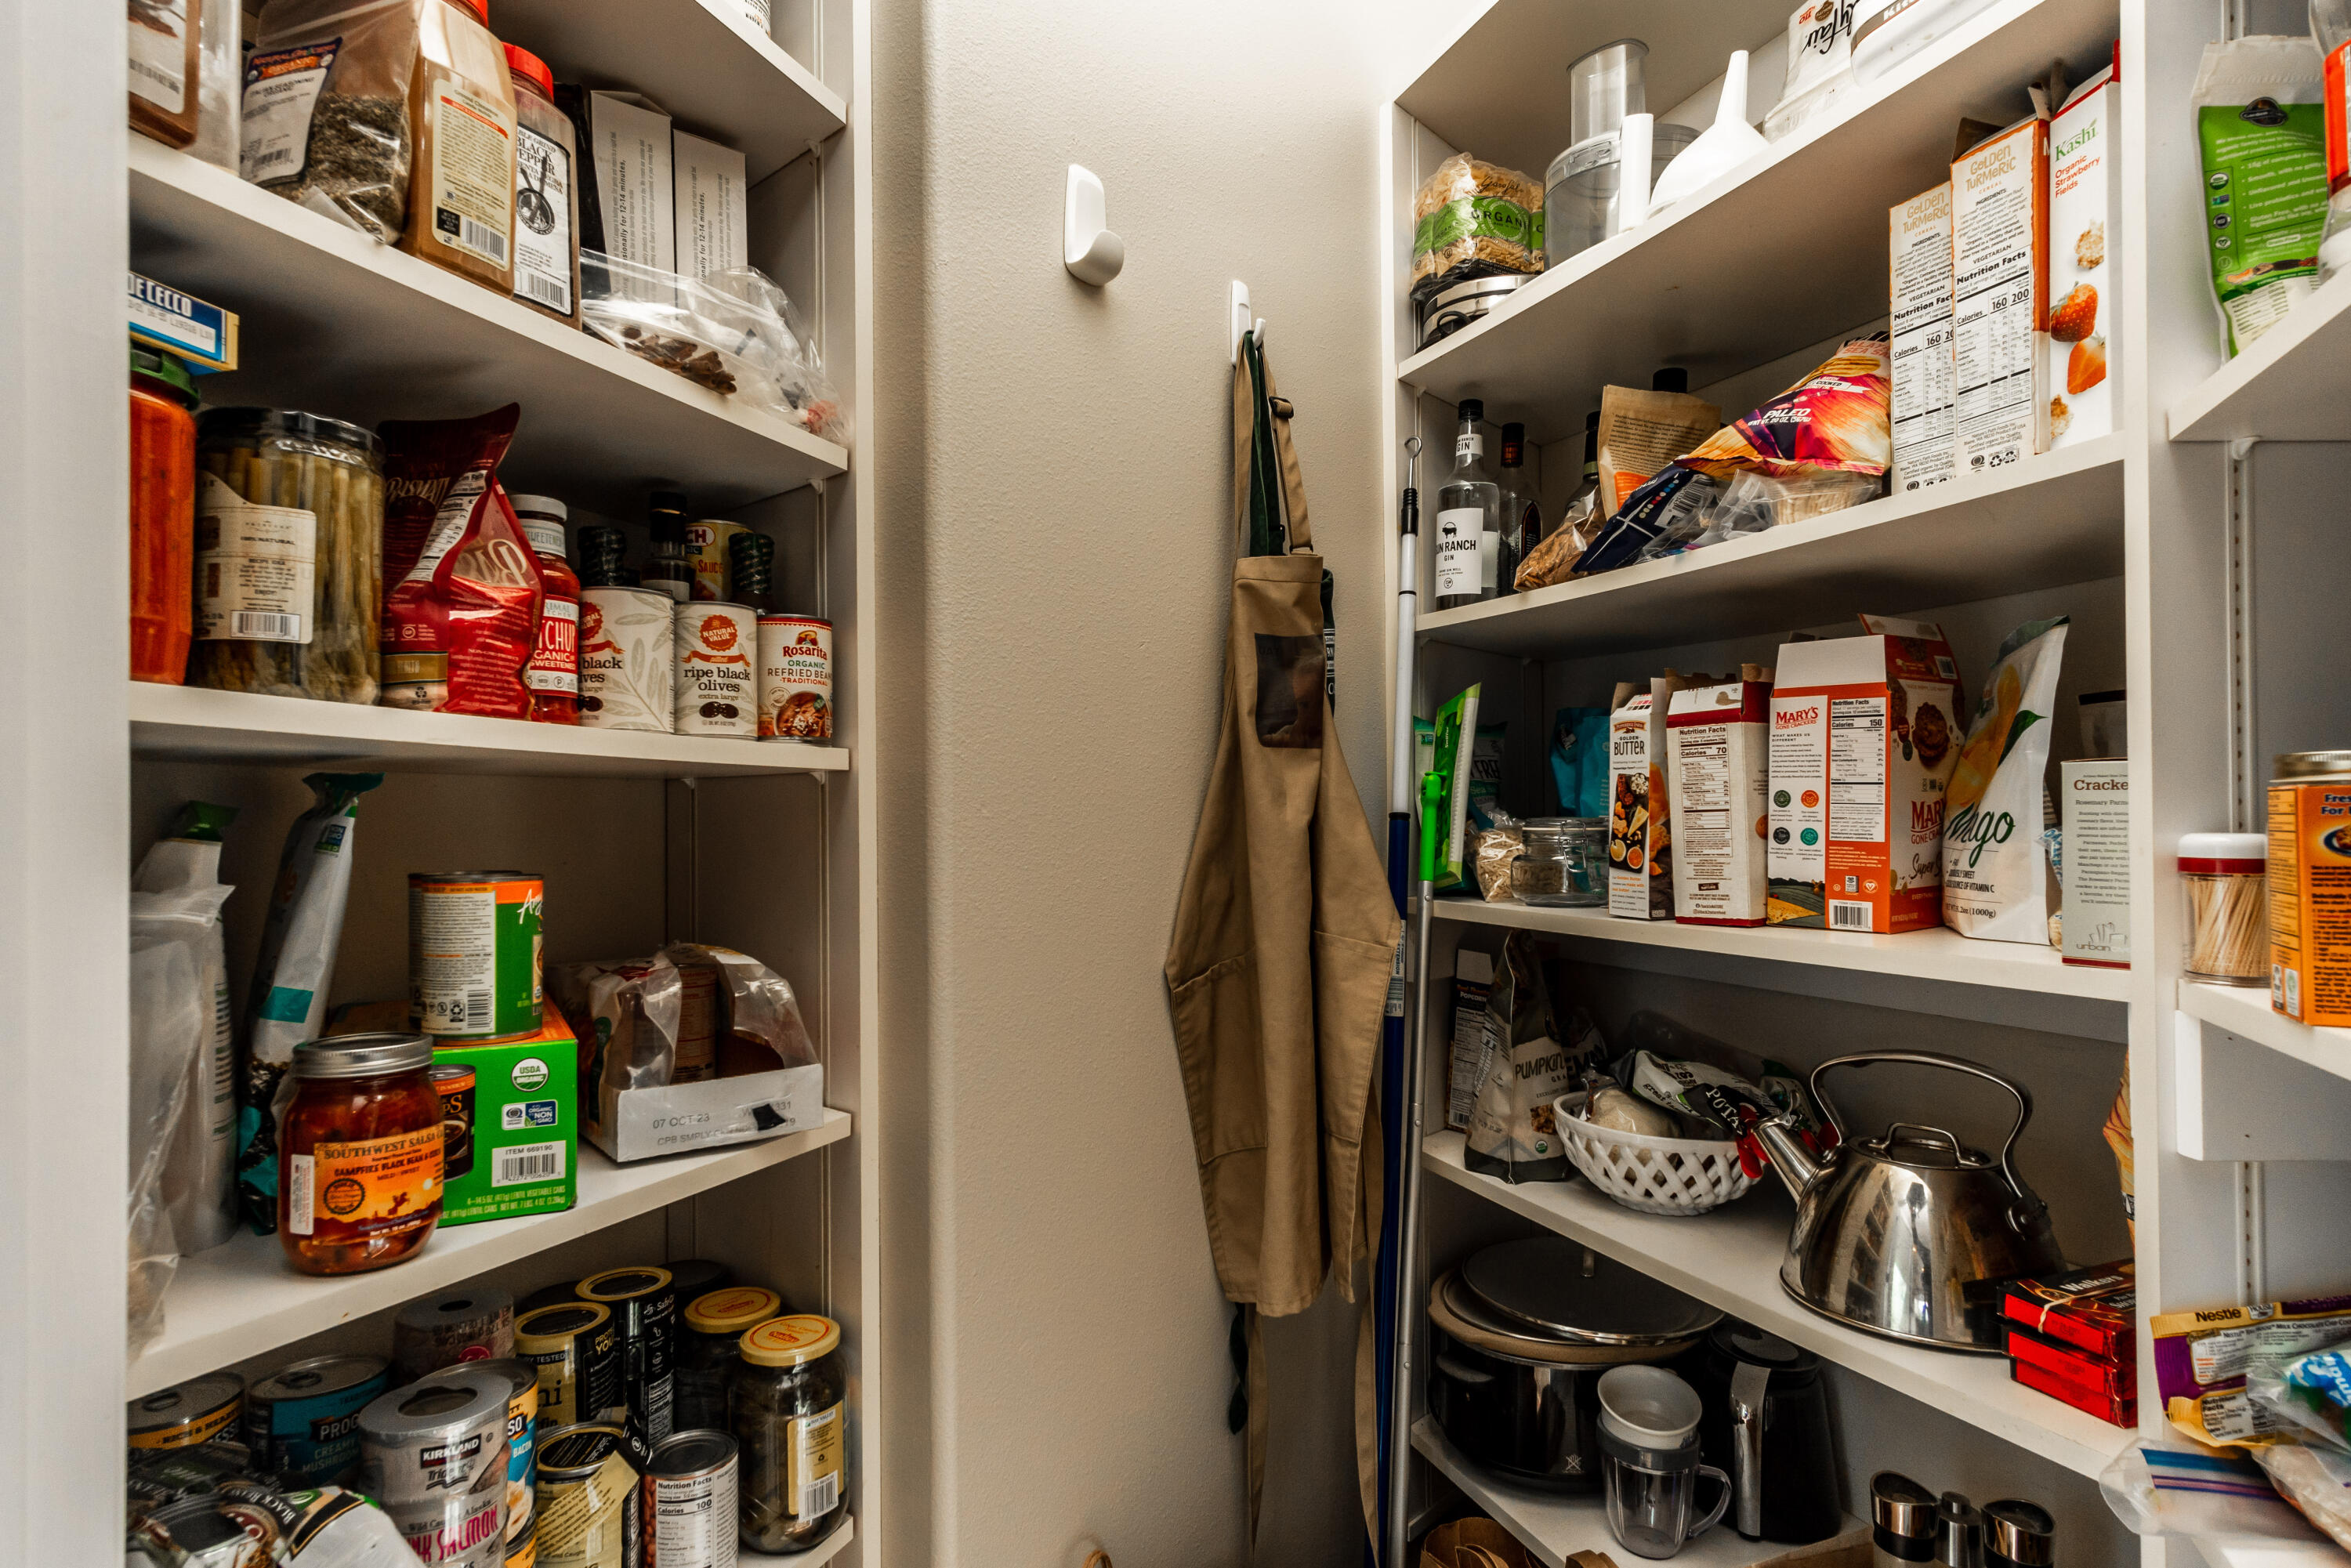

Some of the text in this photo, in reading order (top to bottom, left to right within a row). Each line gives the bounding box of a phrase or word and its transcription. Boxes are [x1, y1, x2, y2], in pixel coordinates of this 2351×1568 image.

[516, 136, 552, 163] BLACK
[2055, 125, 2098, 161] Kashi
[516, 150, 556, 176] EPPR
[2055, 154, 2088, 179] Organic
[2055, 157, 2101, 190] Strawberry
[2055, 179, 2078, 198] Fields
[1471, 208, 1527, 230] ORGANI
[1972, 244, 2012, 264] VEGETARIAN
[1956, 251, 2027, 285] Nutrition Facts
[146, 280, 192, 317] CECCO
[1908, 284, 1946, 303] VEGETARIAN
[1893, 293, 1954, 321] Nutrition Fact
[1957, 288, 2030, 324] Calories 160 200
[1893, 327, 1954, 358] Calories 160 20
[1762, 407, 1812, 419] PALEO
[1457, 441, 1470, 452] GIN
[1444, 539, 1476, 552] RANCH
[702, 627, 736, 638] NATURAL
[708, 632, 730, 643] VALUE
[534, 650, 571, 662] GANIC
[782, 646, 828, 661] Rosarita
[582, 656, 624, 669] black
[788, 660, 826, 670] ORGANIC
[579, 672, 605, 683] ives
[683, 666, 751, 681] ripe black
[767, 668, 833, 681] REFRIED BEAN
[697, 679, 741, 693] olives
[720, 693, 739, 702] large
[1775, 706, 1819, 725] MARY'S
[1790, 719, 1817, 729] CRACKERS
[2073, 779, 2128, 791] Cracke
[1911, 798, 1945, 830] MAR
[2320, 806, 2344, 815] For
[1911, 833, 1929, 845] GONE
[1962, 871, 1975, 879] SWEET
[1969, 883, 1990, 893] VITAMIN
[1990, 884, 1994, 893] C
[516, 888, 543, 925] Amy
[1969, 907, 1996, 918] (1000g)
[2076, 942, 2111, 952] urban
[1460, 990, 1487, 1001] POPCORN
[519, 1065, 541, 1074] USDA
[534, 1110, 553, 1119] NON
[652, 1114, 710, 1129] 07 OCT 23
[323, 1140, 406, 1160] SOUTHWEST
[408, 1131, 437, 1147] SALSA
[657, 1135, 678, 1146] CPB
[505, 1147, 524, 1156] ITEM
[381, 1158, 405, 1171] BLACK
[526, 1187, 552, 1198] VEGETABLE
[2058, 1275, 2125, 1291] Walkers
[536, 1349, 567, 1363] TESTED
[2202, 1395, 2237, 1413] Nutrition Facts
[422, 1437, 480, 1461] KIRKLAND
[513, 1439, 532, 1459] BACON
[657, 1476, 712, 1490] Nutrition Facts
[261, 1495, 298, 1526] BLACK
[695, 1498, 712, 1511] 100
[437, 1503, 498, 1562] SALMON
